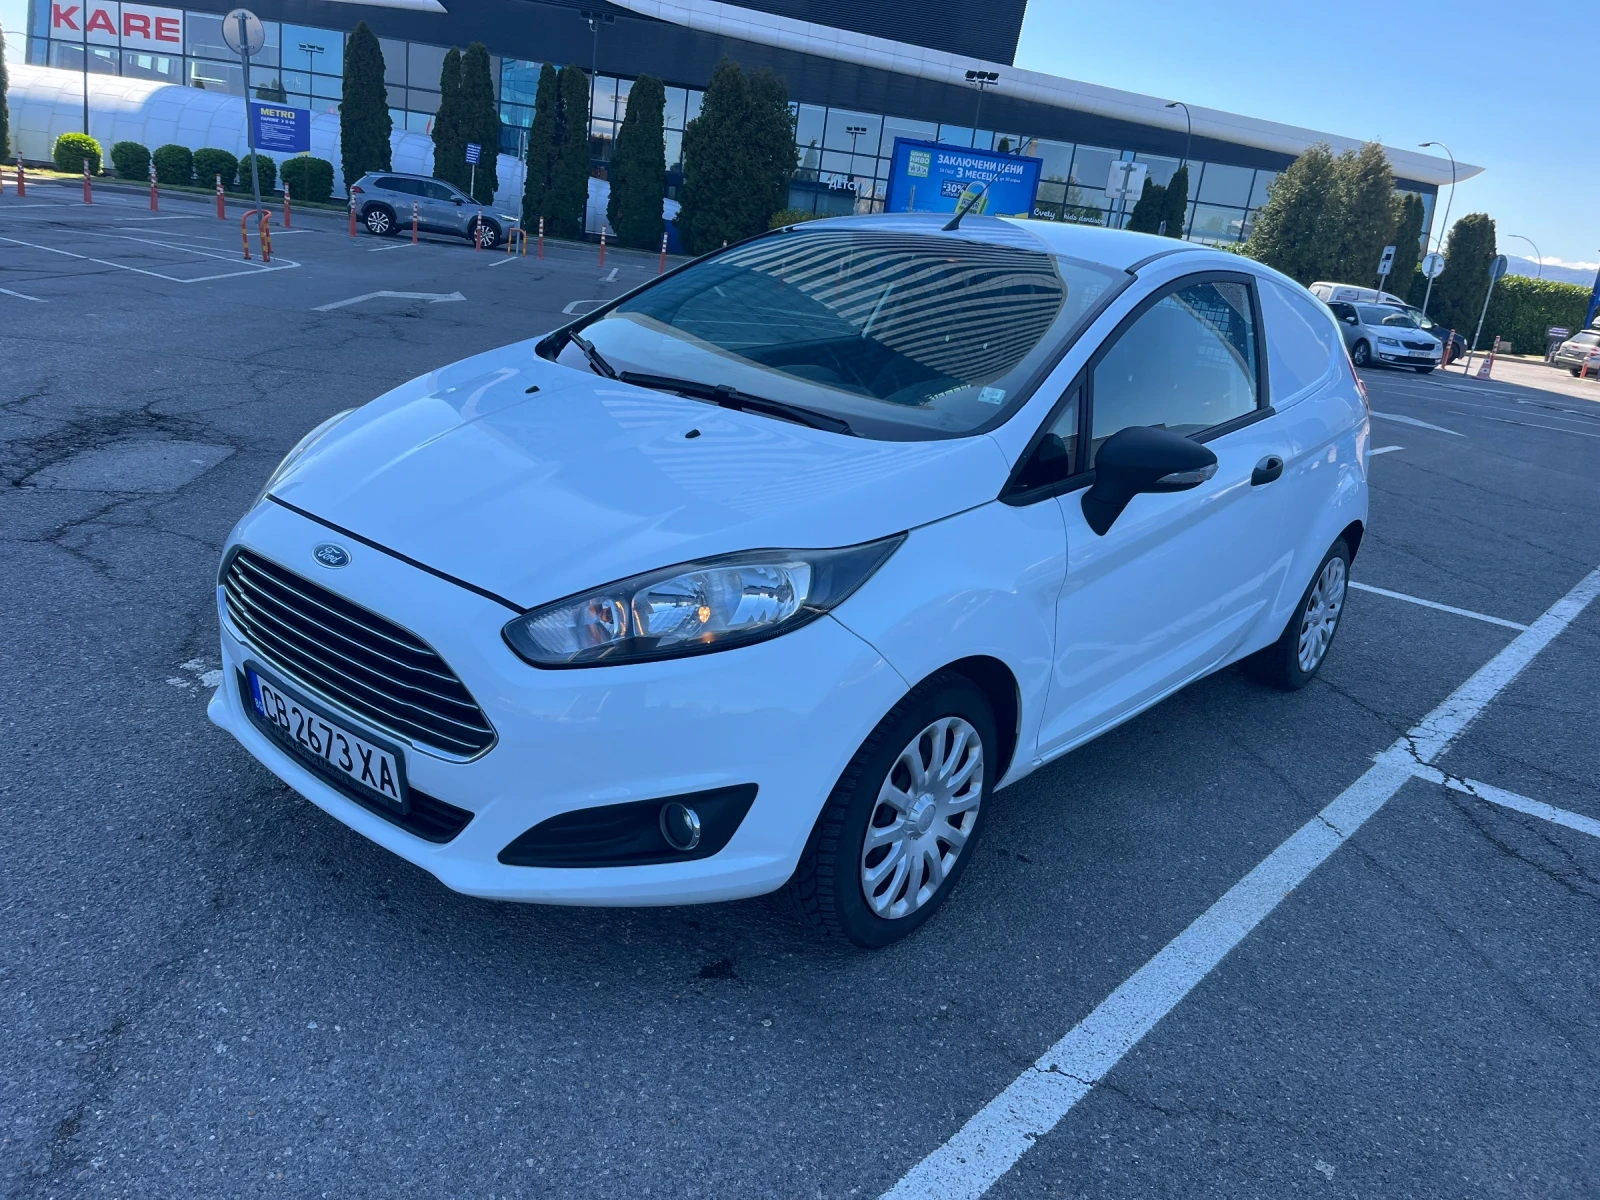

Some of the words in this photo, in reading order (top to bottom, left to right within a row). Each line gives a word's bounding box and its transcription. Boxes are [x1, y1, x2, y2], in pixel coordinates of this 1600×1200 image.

[53, 4, 180, 43] KARE
[260, 107, 295, 119] METRO
[909, 156, 930, 165] НИВО
[937, 154, 997, 171] ЗАКЛЮЧЕНИ
[997, 163, 1024, 175] ЦЕНИ
[1063, 213, 1077, 221] kids
[1078, 214, 1108, 226] dentistry
[318, 546, 343, 564] Ford
